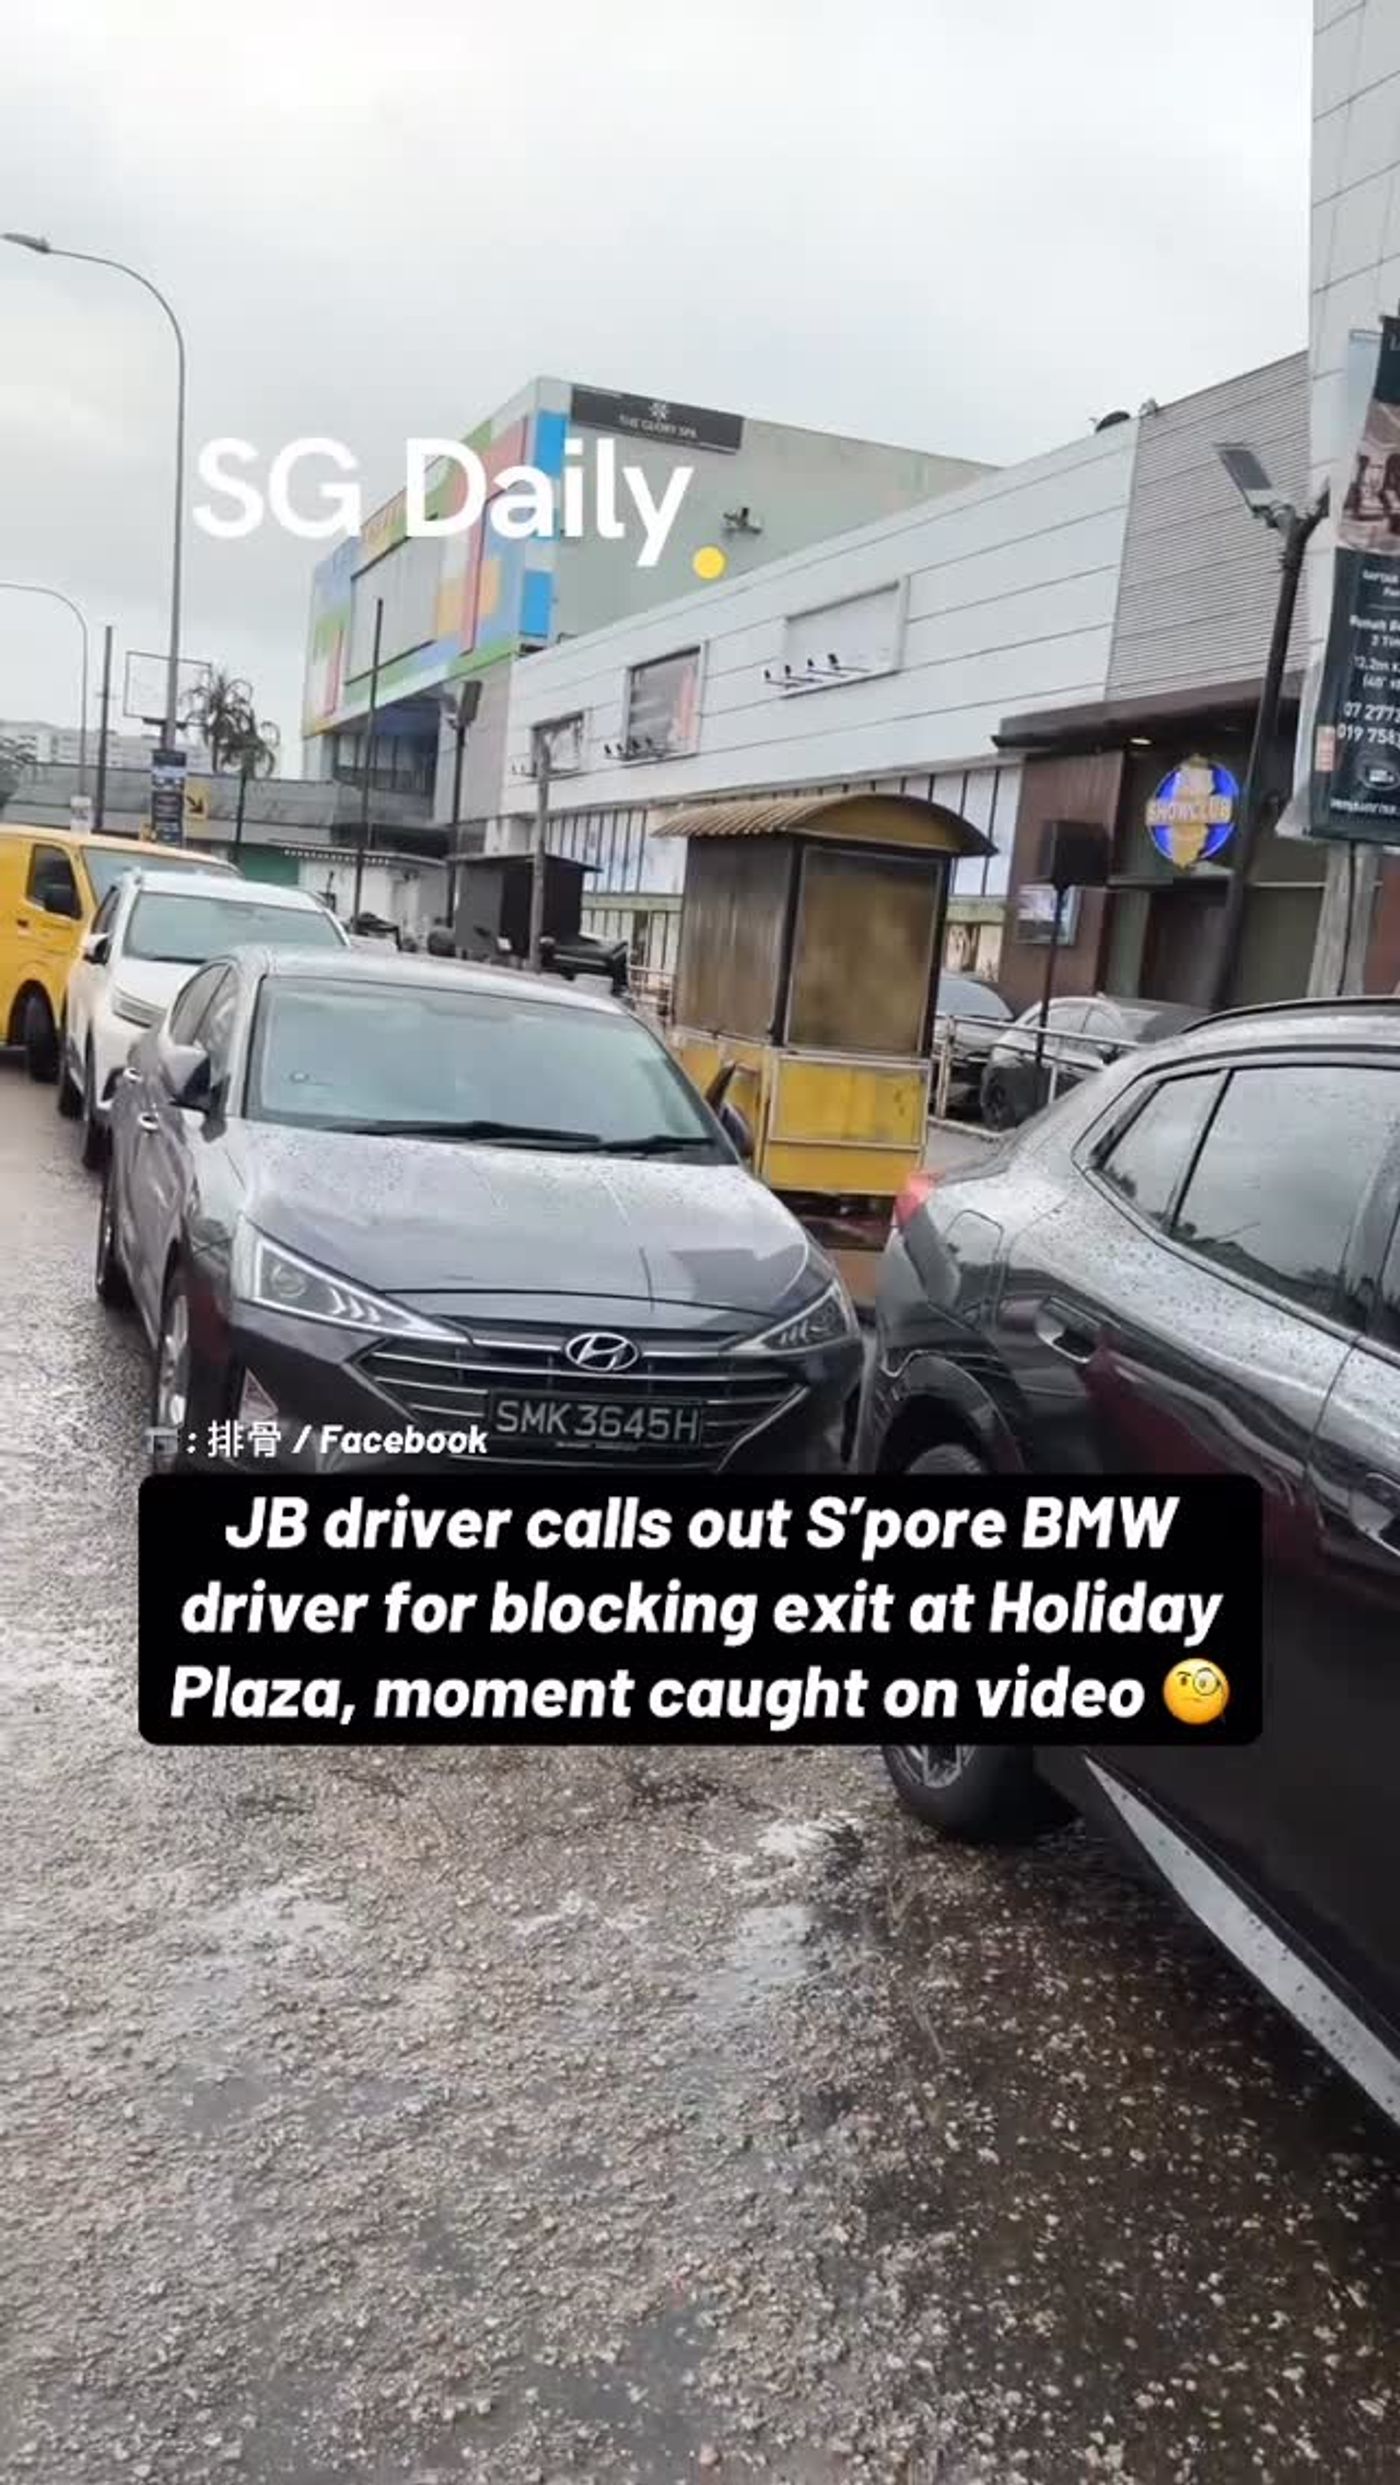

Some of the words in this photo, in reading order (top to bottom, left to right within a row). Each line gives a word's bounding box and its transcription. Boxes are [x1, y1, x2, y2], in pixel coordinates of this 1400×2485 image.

[1343, 701, 1363, 718] 07
[1337, 722, 1364, 743] 019
[496, 1400, 699, 1441] SMK3645H
